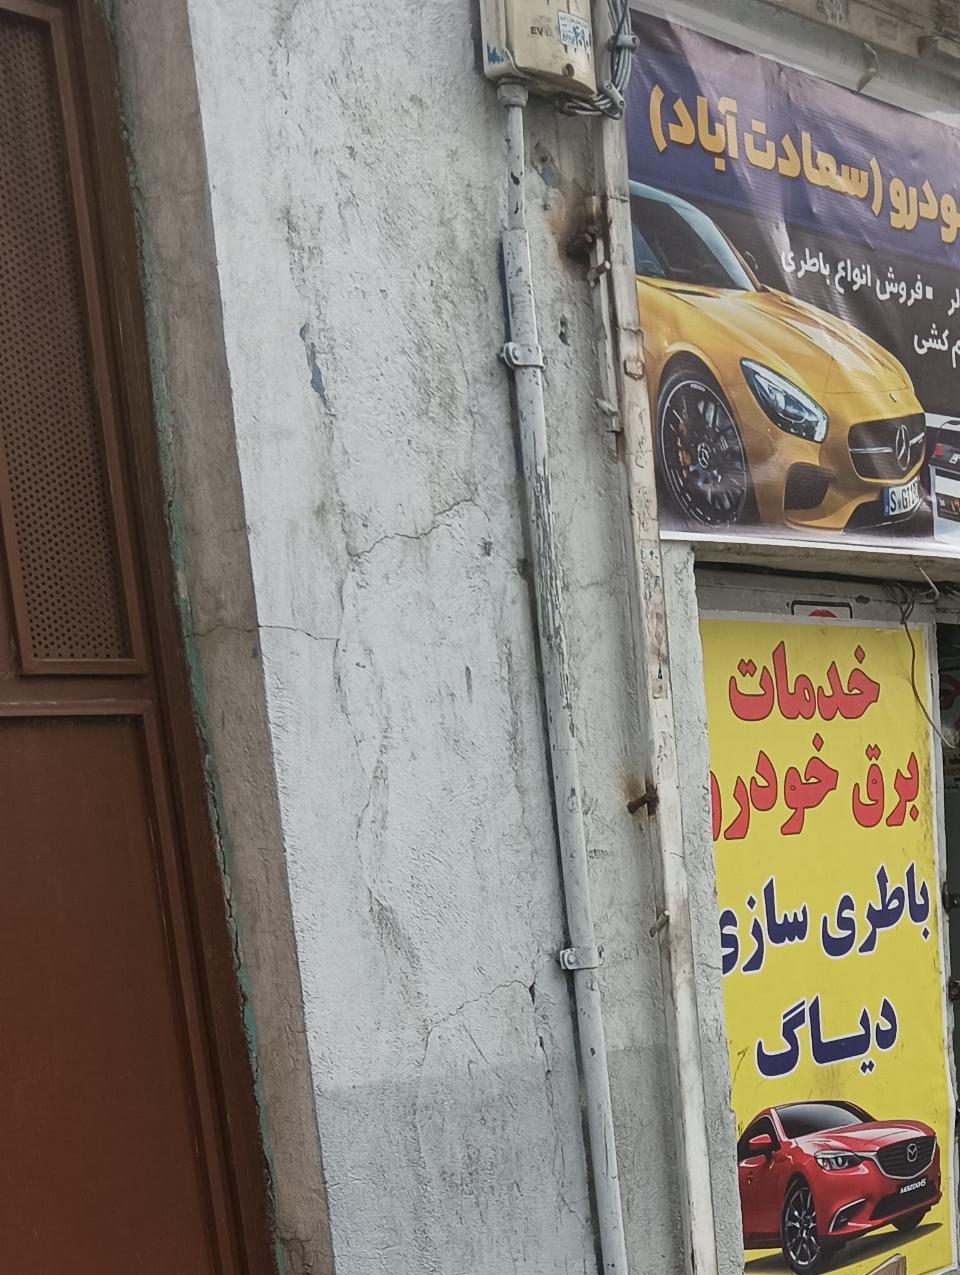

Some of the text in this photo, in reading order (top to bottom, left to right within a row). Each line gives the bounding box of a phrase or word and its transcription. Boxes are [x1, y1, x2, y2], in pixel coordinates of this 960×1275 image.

[649, 84, 739, 172] آباد)
[744, 120, 884, 217] (سعادت
[834, 258, 871, 294] انواع
[876, 267, 923, 306] فروش
[913, 323, 950, 355] کشی
[728, 640, 881, 722] خدمات
[852, 743, 920, 828] برق
[820, 861, 931, 959] باطری
[756, 993, 898, 1077] دیاگ
